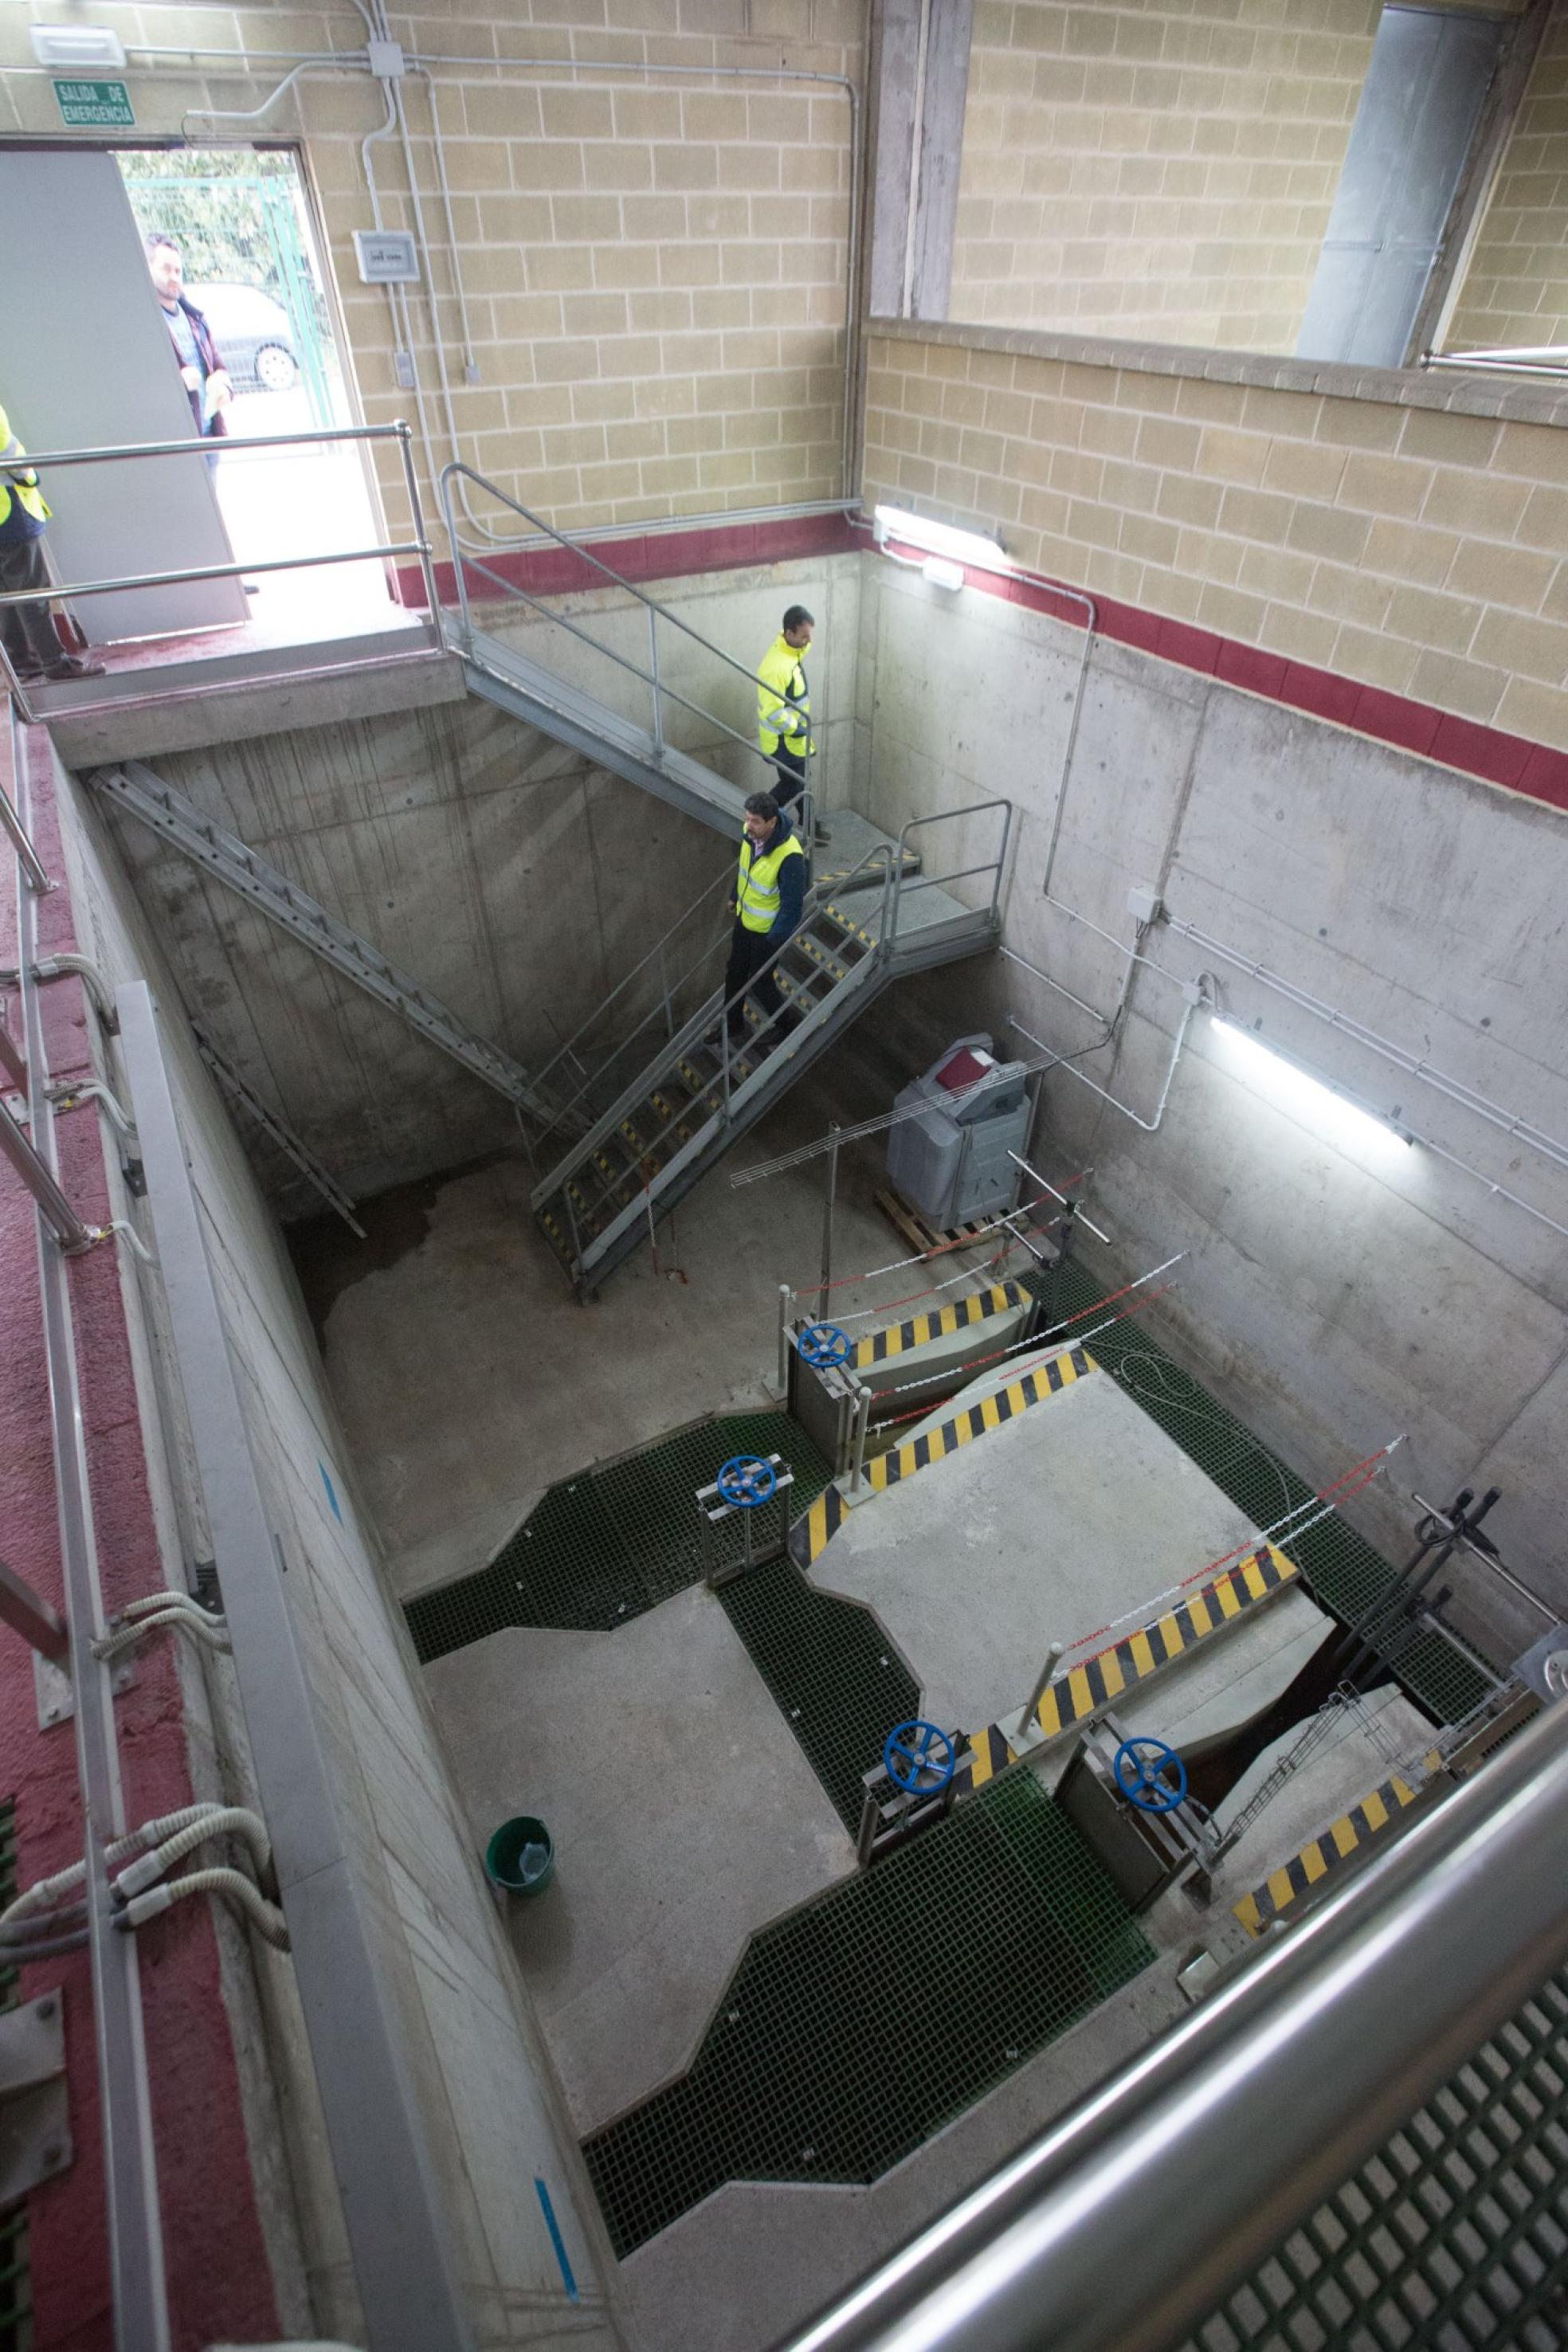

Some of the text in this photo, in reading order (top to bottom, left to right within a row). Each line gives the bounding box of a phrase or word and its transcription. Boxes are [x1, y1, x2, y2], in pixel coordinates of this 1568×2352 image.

[59, 85, 125, 102] SALIDA DE
[63, 105, 132, 122] EMERGENCIA
